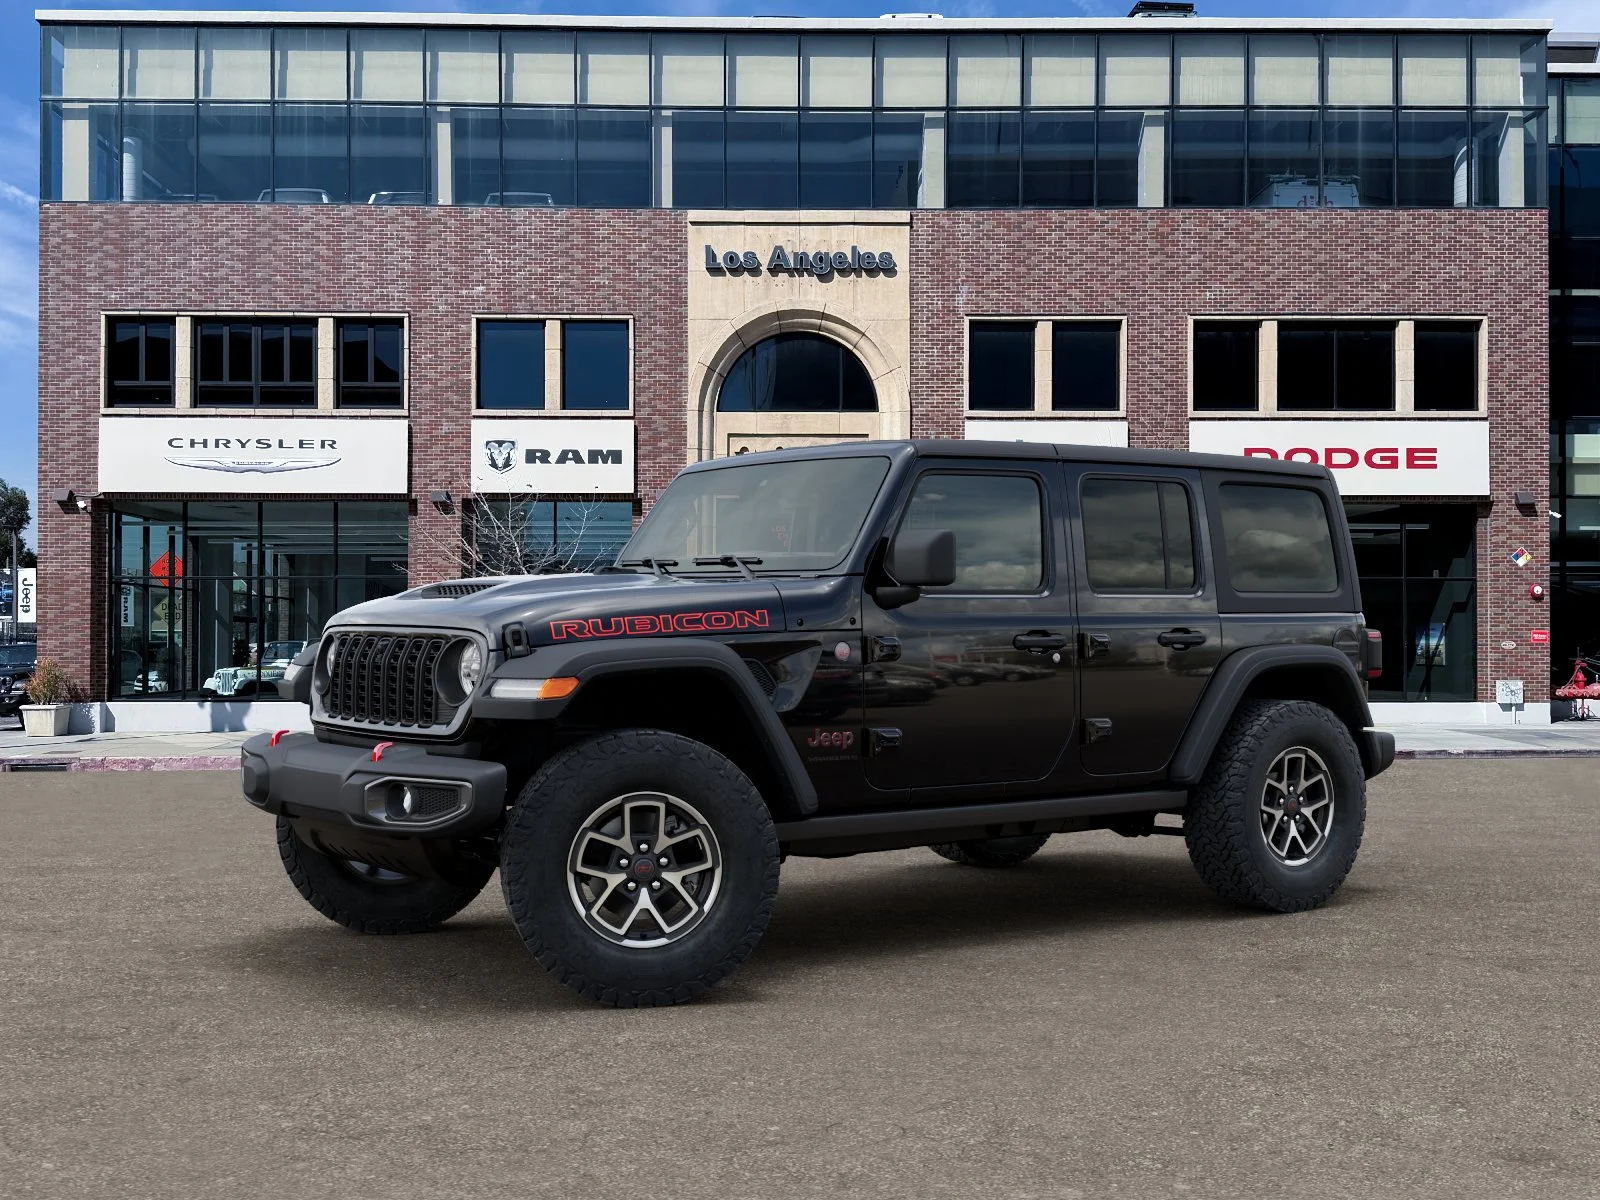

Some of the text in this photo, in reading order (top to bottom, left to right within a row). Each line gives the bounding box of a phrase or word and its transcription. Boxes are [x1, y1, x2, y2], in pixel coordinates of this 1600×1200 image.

[704, 244, 895, 276] Los Angeles
[167, 437, 338, 450] CHRYSLER
[525, 448, 623, 465] RAM
[20, 577, 34, 614] Jeep
[164, 612, 181, 620] ED
[550, 609, 769, 640] RUBICON
[807, 727, 854, 750] Jeep
